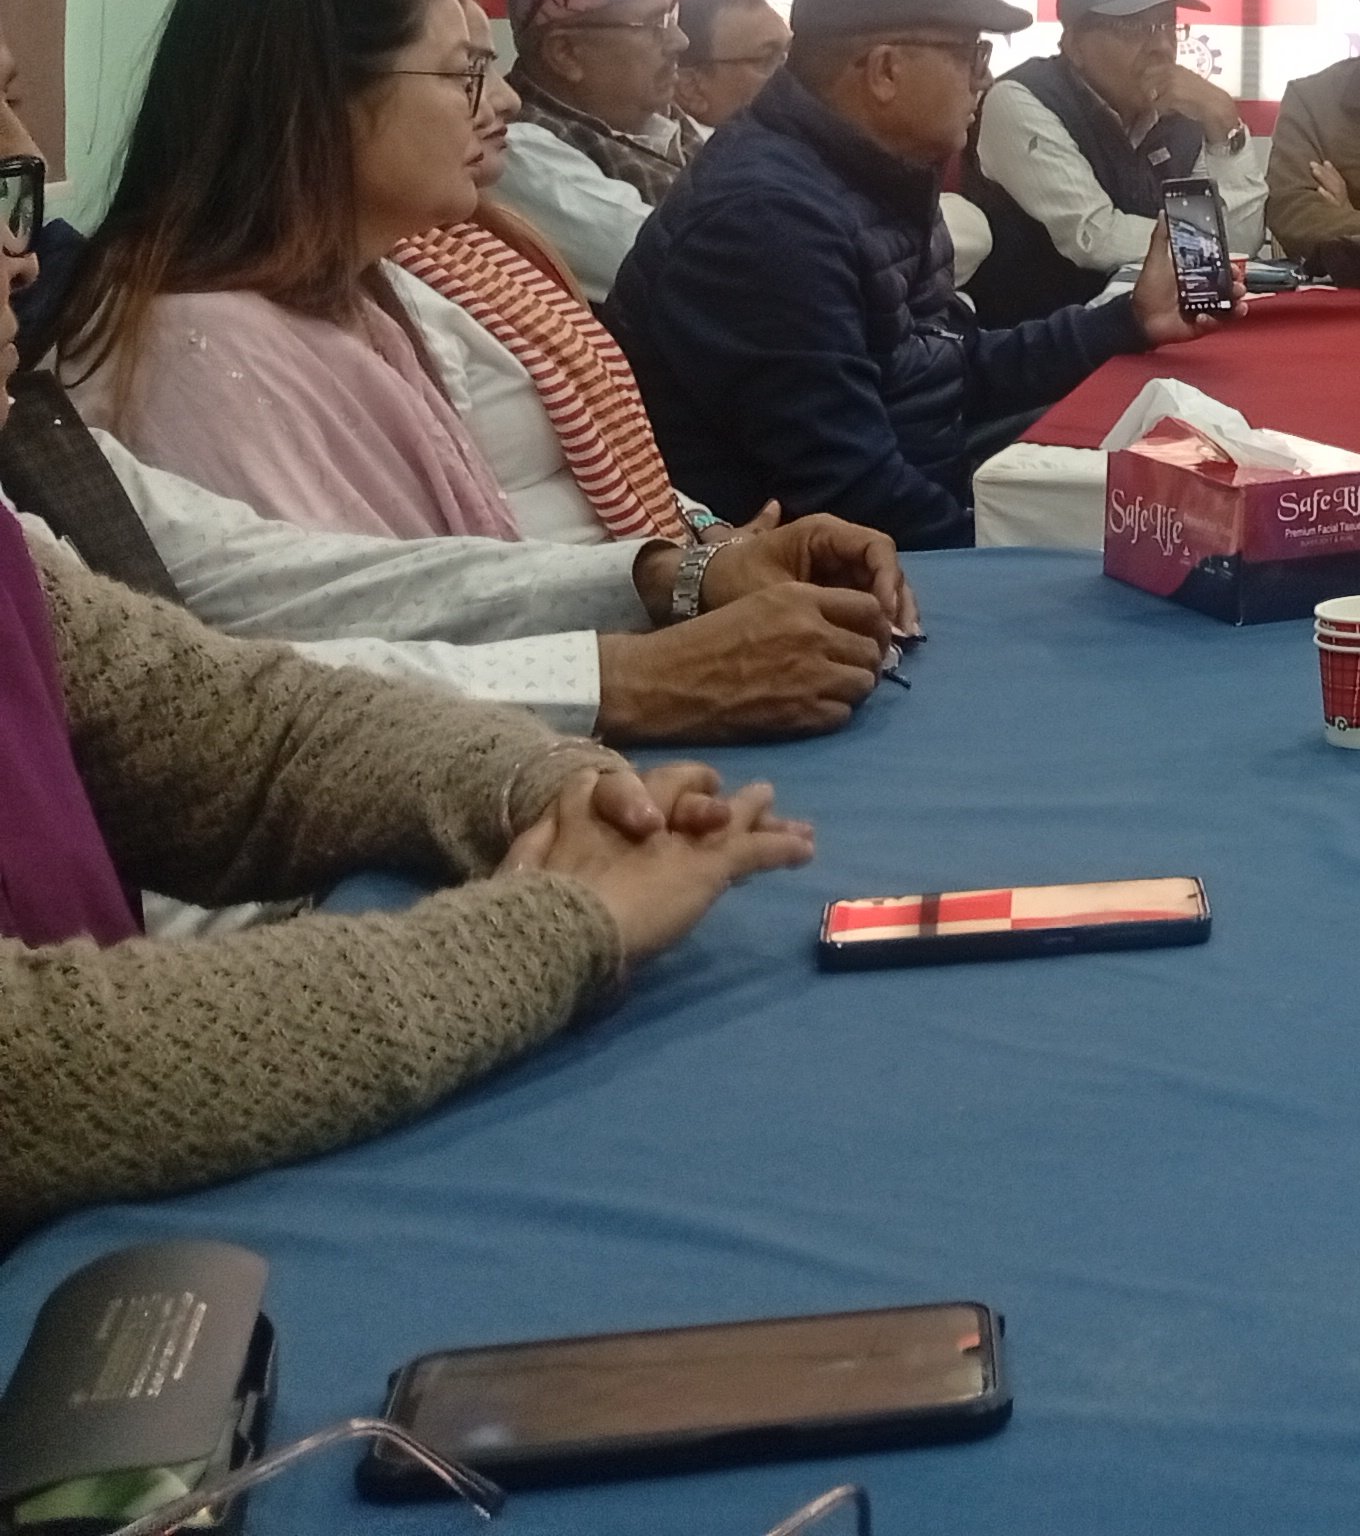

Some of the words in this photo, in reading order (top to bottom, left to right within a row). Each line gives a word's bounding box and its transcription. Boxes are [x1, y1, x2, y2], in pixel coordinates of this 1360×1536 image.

[1277, 488, 1331, 521] Safe
[1109, 488, 1149, 544] Safe
[1148, 502, 1184, 556] Life
[1284, 526, 1316, 539] Premium
[1318, 523, 1339, 535] Facial
